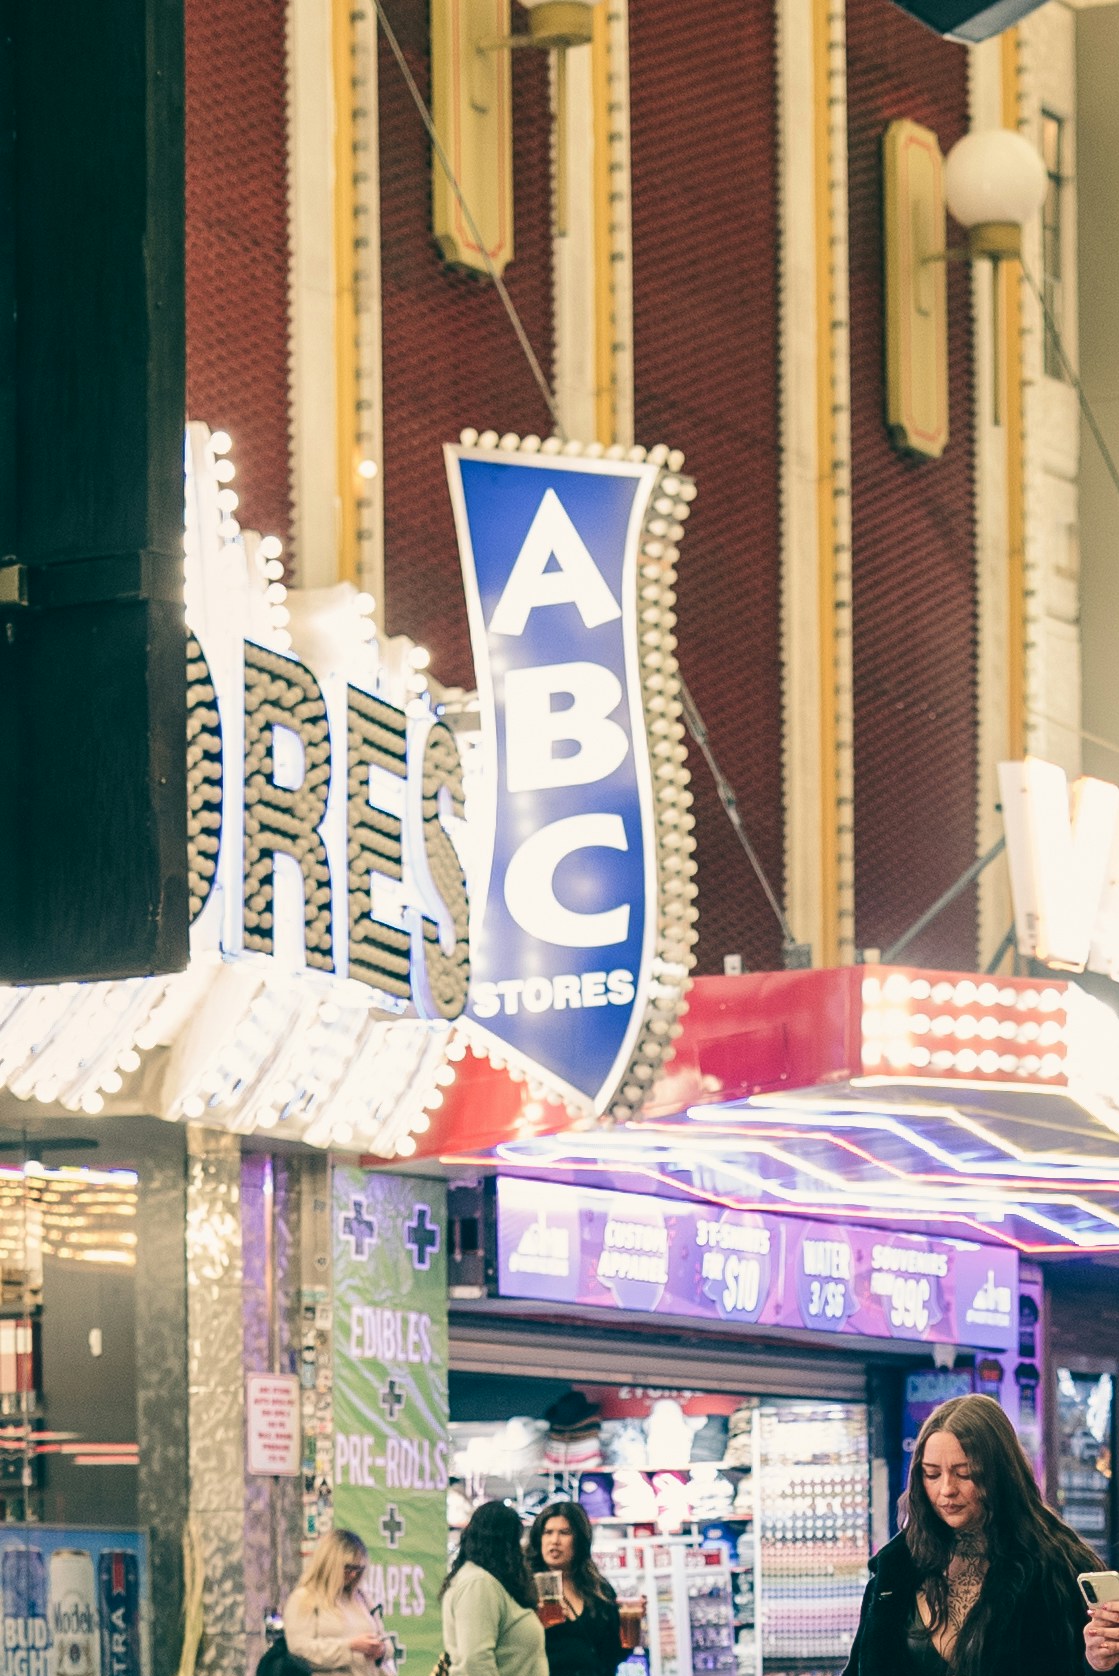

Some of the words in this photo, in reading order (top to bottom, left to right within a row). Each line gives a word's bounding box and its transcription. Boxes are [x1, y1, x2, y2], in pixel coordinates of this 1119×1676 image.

[487, 487, 630, 949] ABC
[470, 967, 635, 1019] STORES
[350, 1305, 432, 1364] EDIBLES
[334, 1432, 449, 1490] PRE-ROLLS
[4, 1616, 47, 1649] BUD
